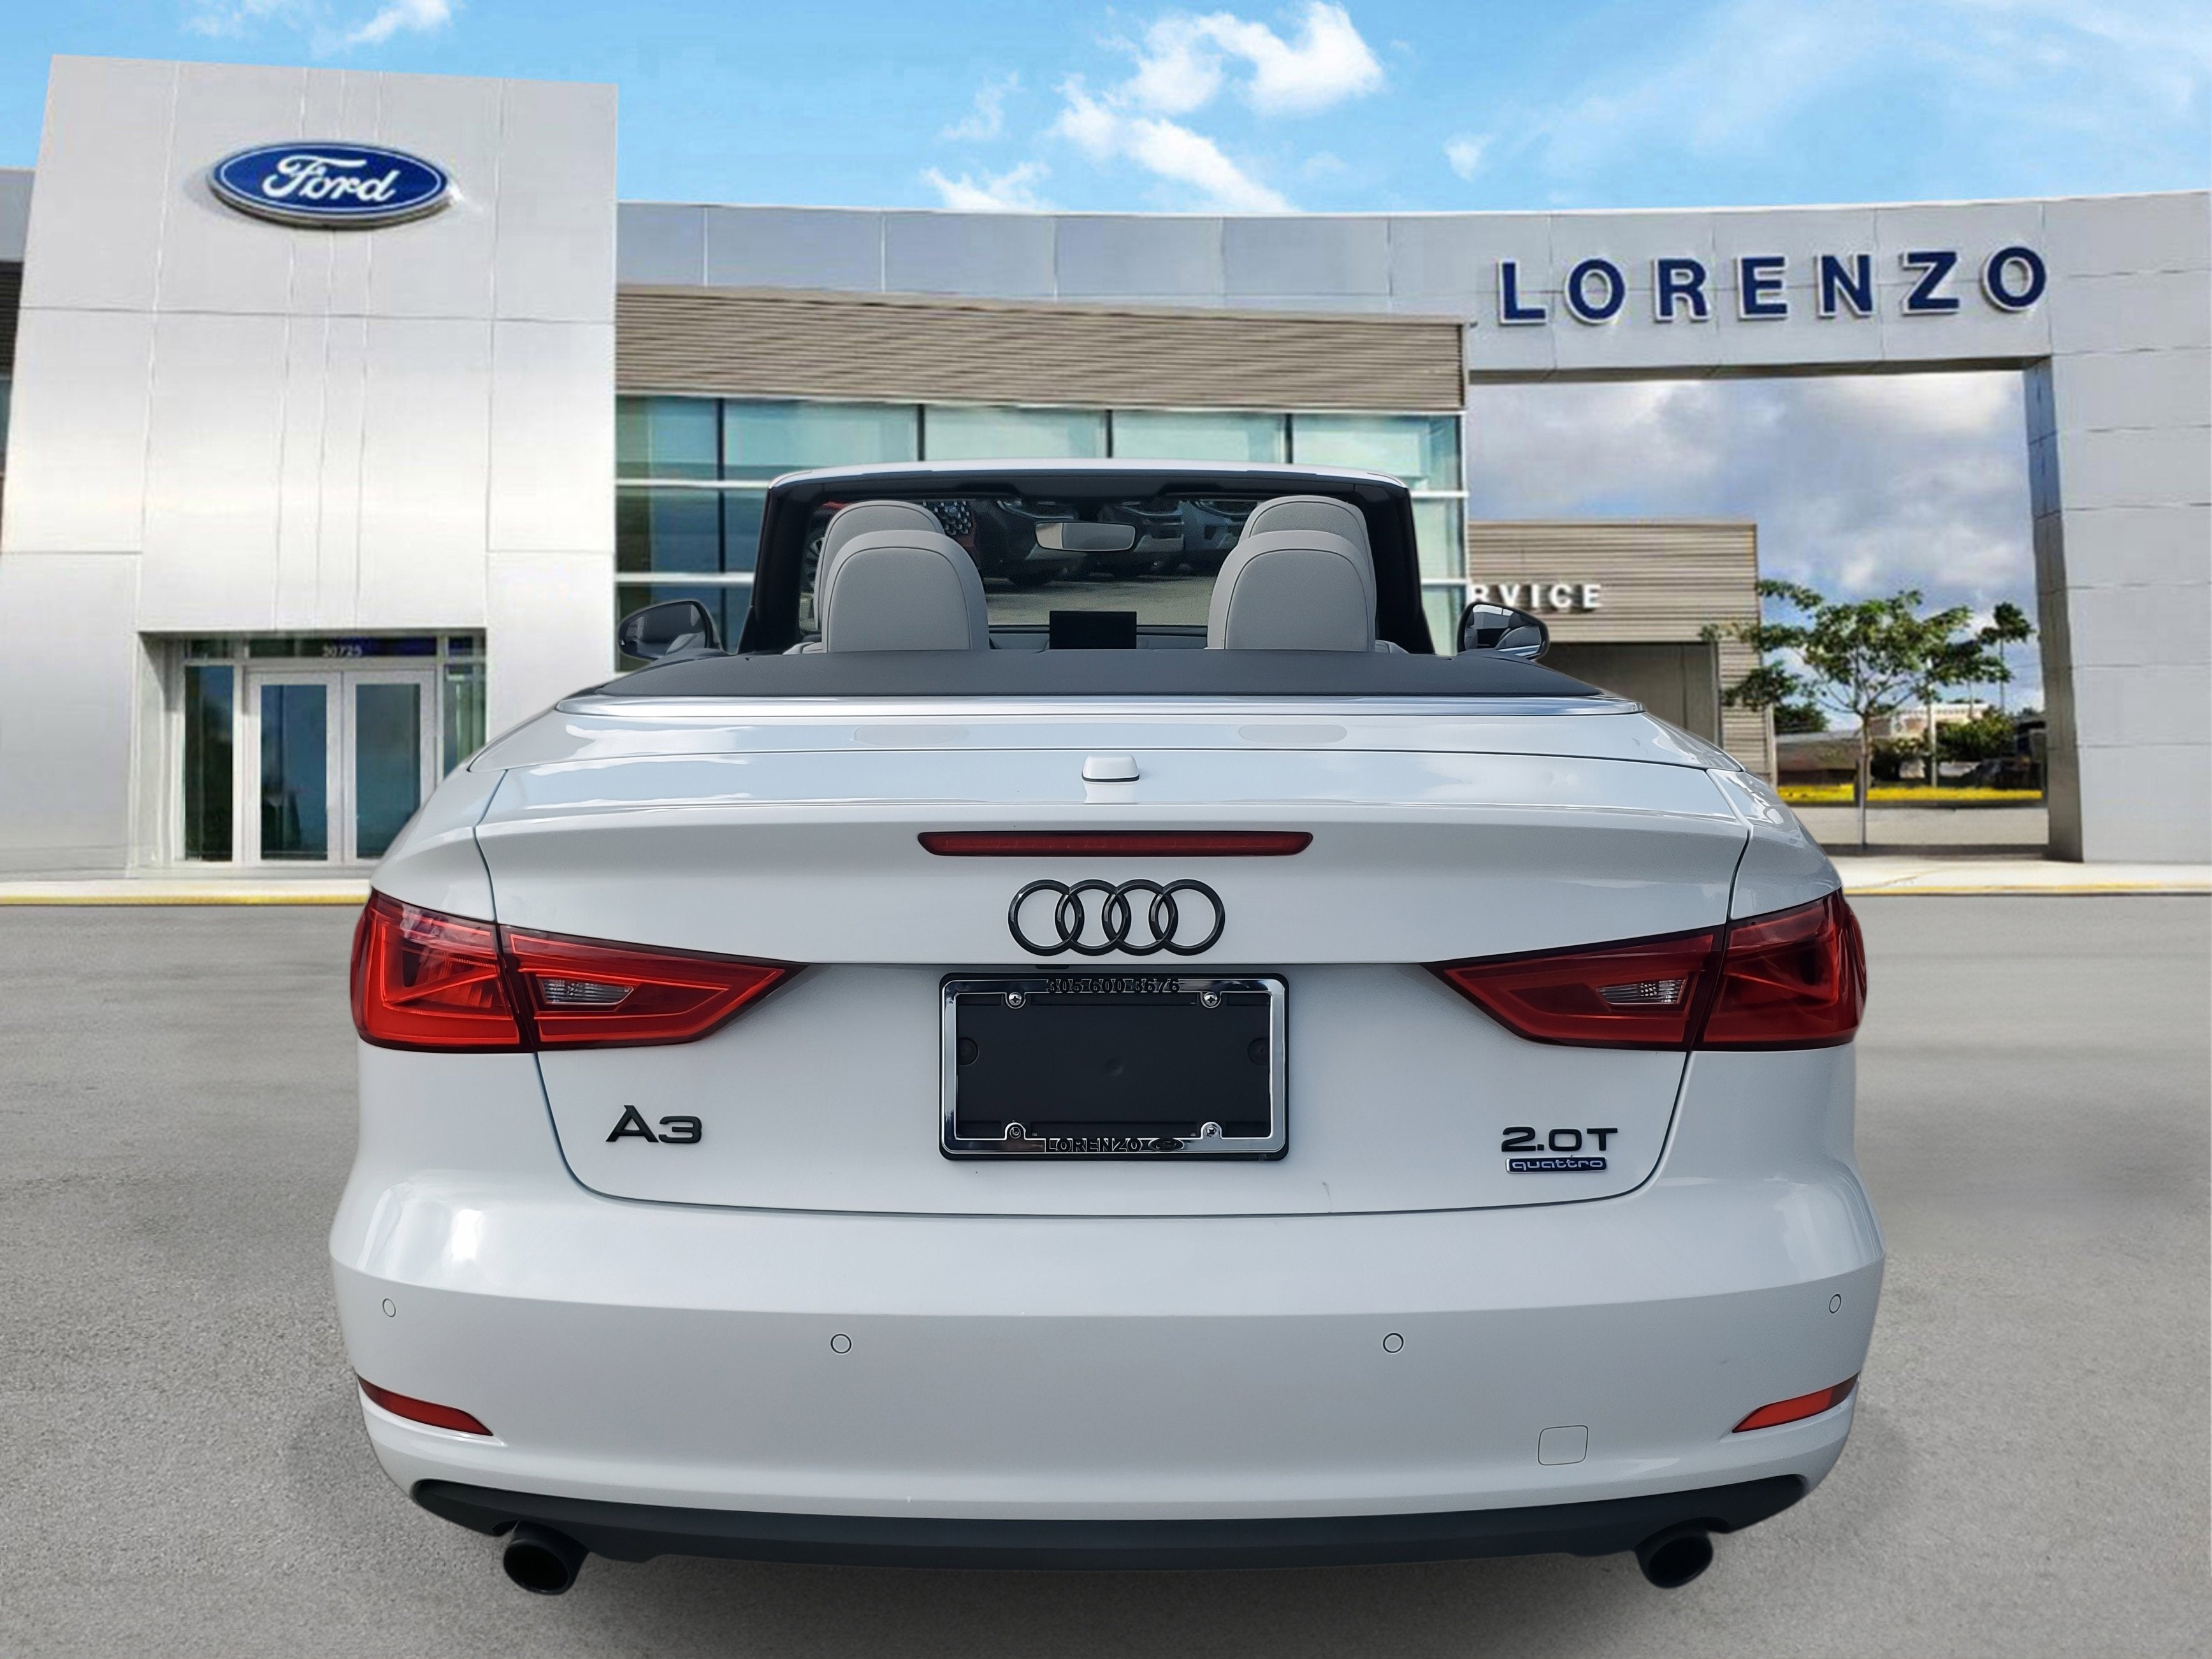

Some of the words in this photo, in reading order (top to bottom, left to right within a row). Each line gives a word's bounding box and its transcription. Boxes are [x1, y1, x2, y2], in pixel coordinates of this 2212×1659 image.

[263, 154, 400, 202] Ford
[1496, 247, 2047, 325] LORENZO
[605, 1105, 702, 1144] A3
[1501, 1126, 1618, 1152] 2.0T
[1046, 1138, 1143, 1152] LORENZO
[1512, 1159, 1603, 1171] quattro
